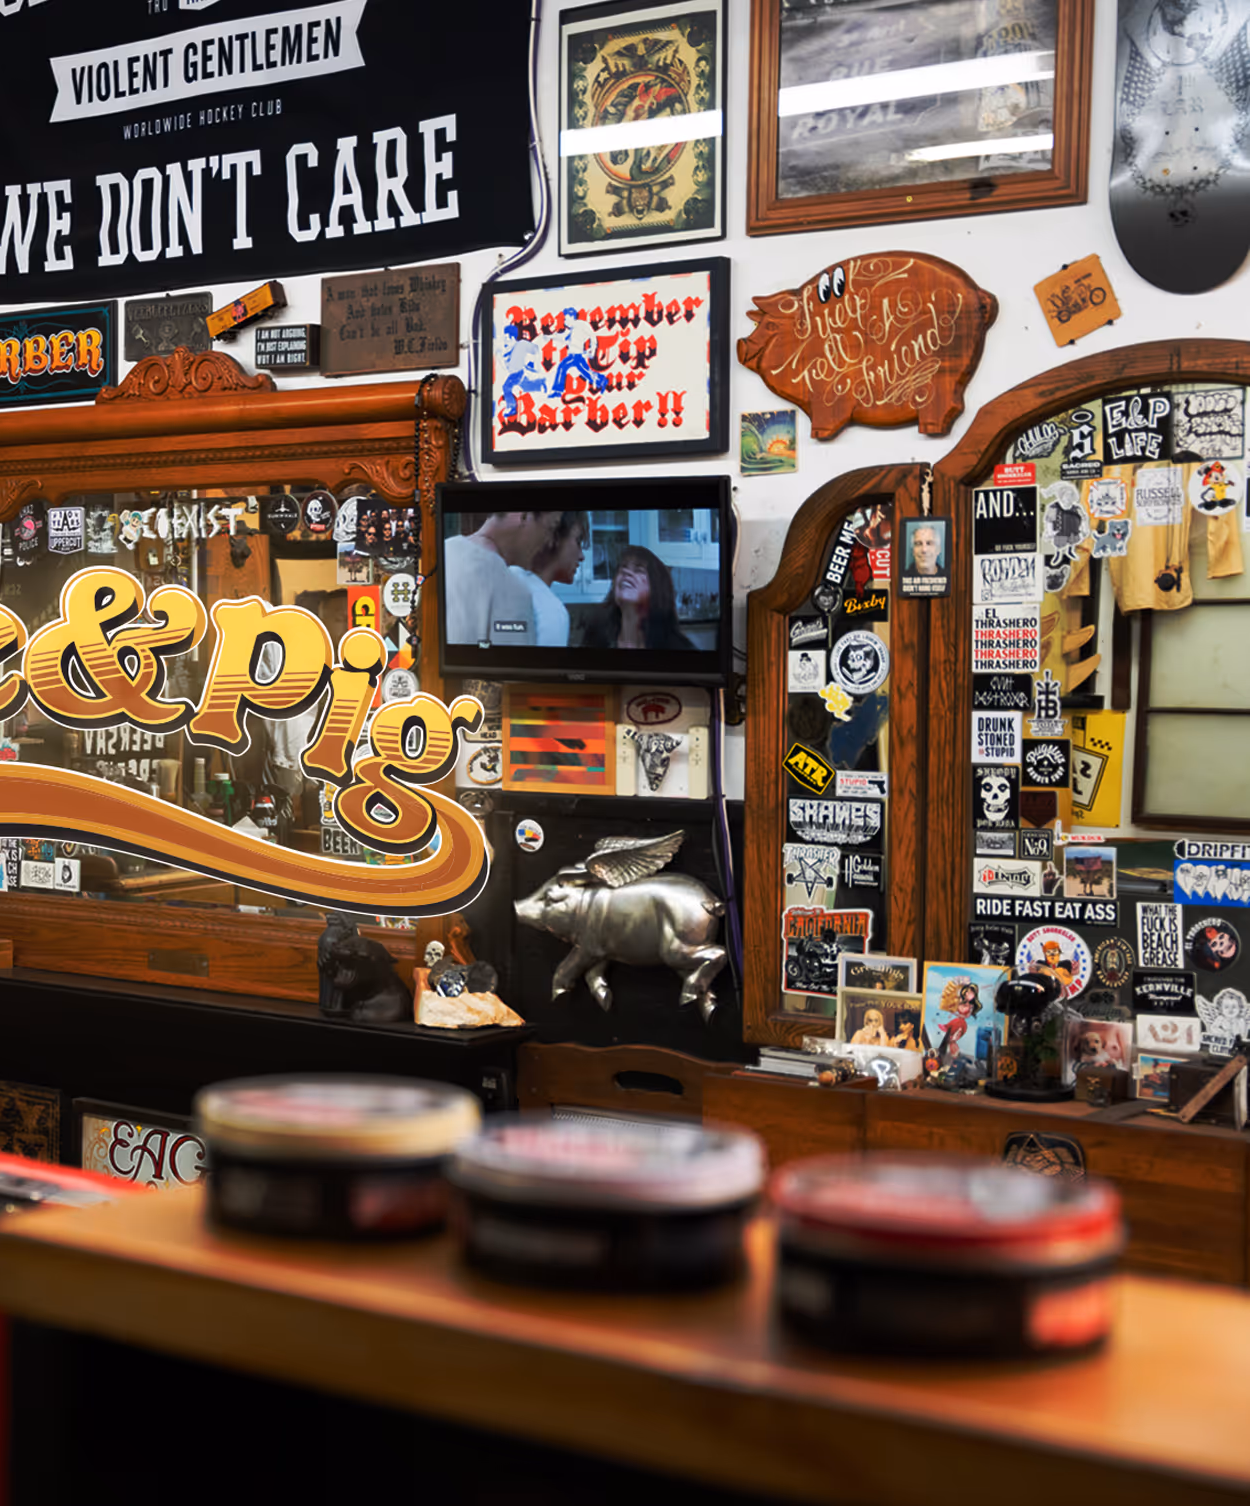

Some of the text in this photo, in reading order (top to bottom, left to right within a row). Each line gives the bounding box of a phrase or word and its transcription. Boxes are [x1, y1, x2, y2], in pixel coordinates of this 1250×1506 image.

[70, 16, 343, 106] VIOLENT GENTLEMEN
[123, 98, 283, 140] WORLDWIDE HOCKEY CLUB
[96, 149, 261, 267] DON'T
[285, 113, 460, 243] CARE
[408, 275, 447, 296] Whiskey
[1108, 432, 1164, 460] LIFE
[1136, 488, 1181, 499] RUSSELL
[18, 537, 40, 551] POLICE
[826, 547, 851, 584] BEER
[985, 608, 998, 619] EL
[974, 618, 1037, 629] THRASHERO
[974, 629, 1037, 640] THRASHERO
[974, 639, 1037, 650] THRASHERO
[974, 649, 1037, 660] THRASHERO
[974, 659, 1037, 670] THRASHERO
[978, 717, 1015, 732] DRUNK
[480, 731, 497, 740] HEAD
[978, 733, 1015, 746] STONED
[985, 747, 1015, 757] STUPID
[840, 778, 866, 786] STUPID
[783, 846, 840, 867] THRASHER
[976, 898, 1116, 921] RIDE FAST EAT ASS
[1141, 904, 1177, 916] WHAT THE
[1141, 916, 1166, 932] FUCK
[1169, 917, 1178, 933] IS
[1026, 930, 1041, 943] BUTT
[1142, 933, 1178, 951] BEACH
[1143, 950, 1179, 968] GREASE
[1134, 982, 1194, 997] KERNVILLE
